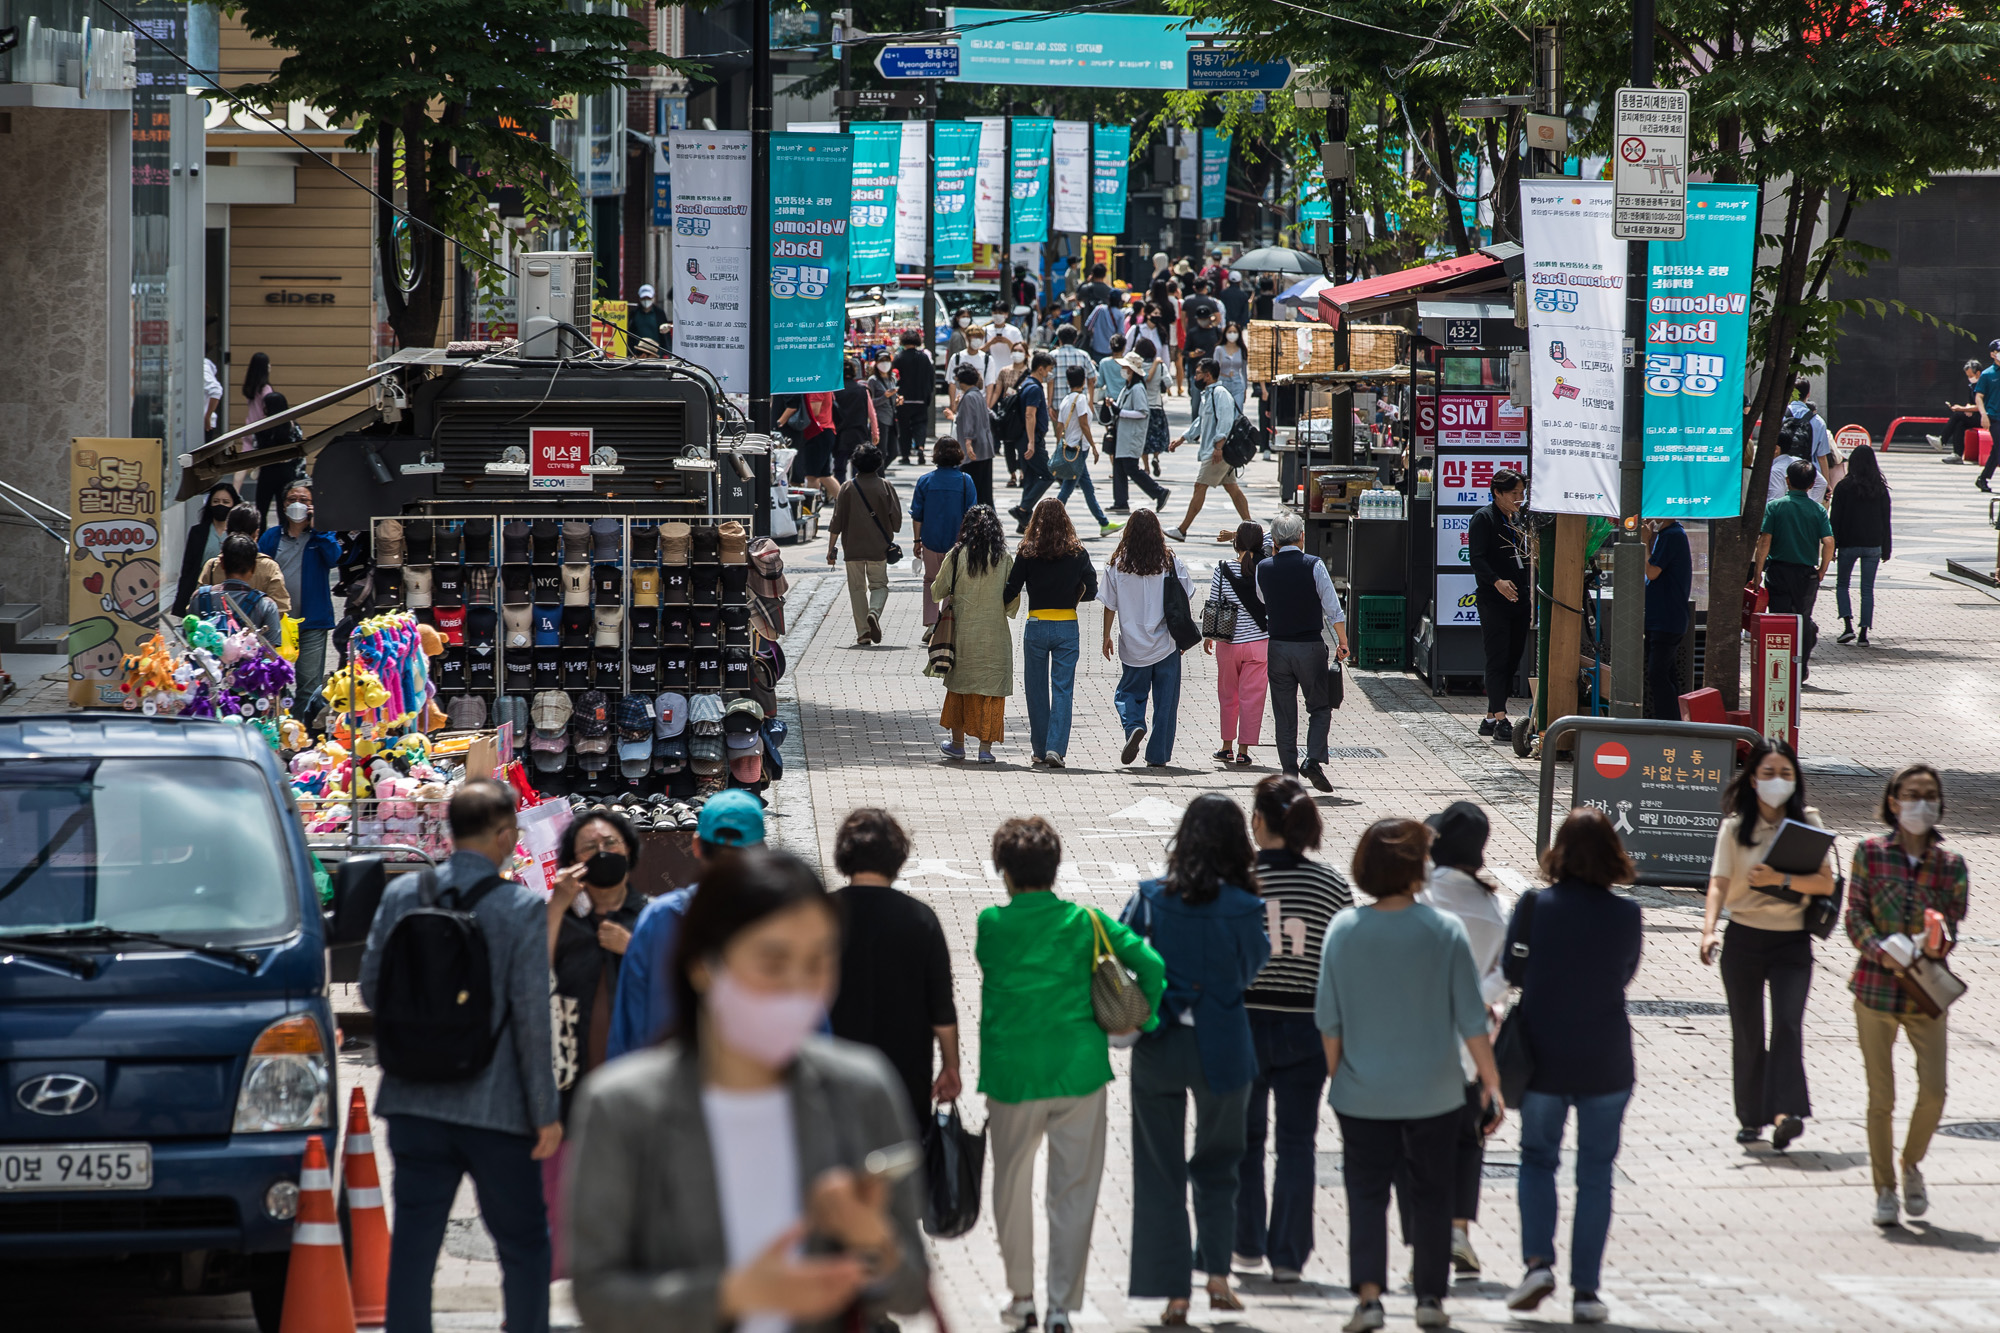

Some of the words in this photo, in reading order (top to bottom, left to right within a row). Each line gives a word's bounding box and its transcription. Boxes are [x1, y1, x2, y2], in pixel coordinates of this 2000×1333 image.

[925, 49, 957, 59] 명동8길
[1193, 69, 1240, 77] Myeongdong
[1242, 69, 1259, 77] 7-gil
[1622, 95, 1684, 110] 통행금지(제한)알림
[1670, 125, 1683, 134] 제외)
[1670, 198, 1681, 207] 일대
[1623, 226, 1675, 234] 남대문경찰서장
[1449, 327, 1477, 338] 43-2
[1441, 404, 1486, 425] SIM
[1840, 438, 1867, 446] 주차금지
[543, 446, 581, 461] 에스원
[99, 457, 142, 489] 5봉
[533, 479, 565, 487] SECOM
[80, 488, 155, 515] 골라담기
[1458, 492, 1477, 502] 사고
[1442, 519, 1470, 530] BES
[83, 528, 144, 546] 20,000
[537, 578, 559, 587] NYC
[440, 619, 461, 627] KOREA
[542, 618, 553, 630] LA
[444, 662, 461, 671] 친구
[700, 661, 718, 670] 최고
[727, 663, 748, 671] 꽃미남
[1640, 814, 1658, 826] 매일
[1663, 815, 1719, 827] 10:00~23:00
[0, 1156, 41, 1182] 0보
[57, 1154, 131, 1181] 9455
